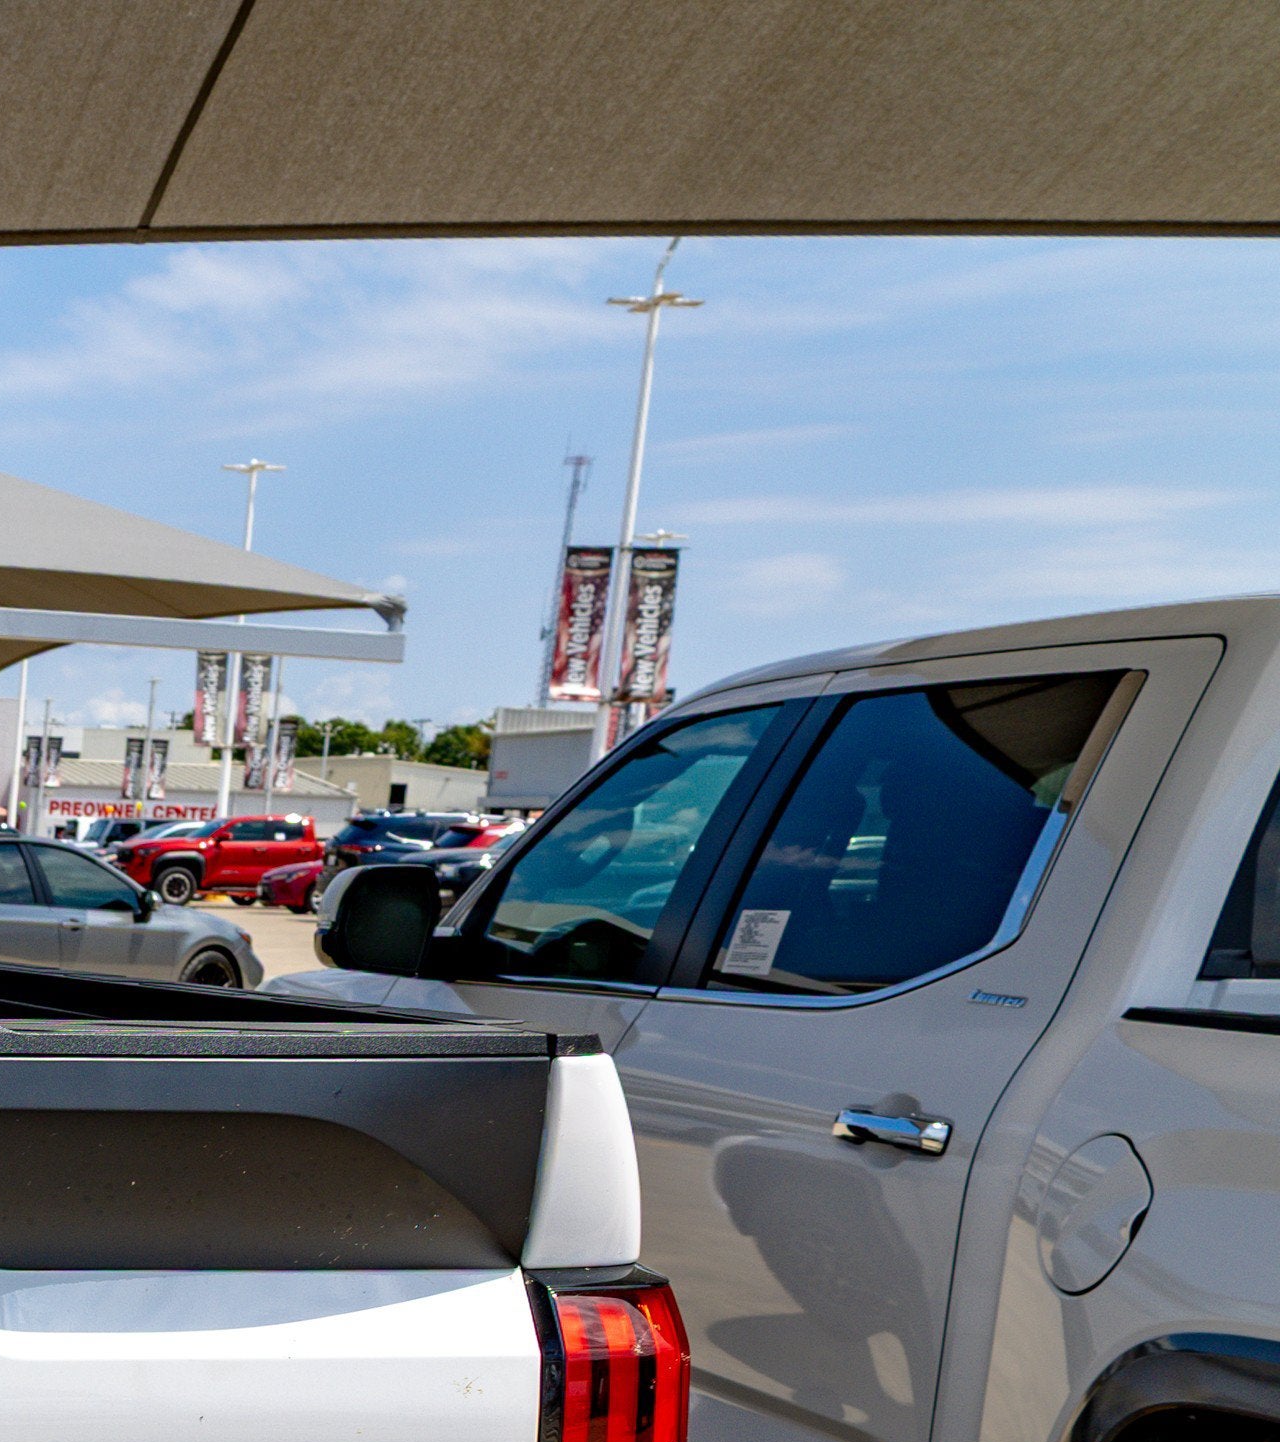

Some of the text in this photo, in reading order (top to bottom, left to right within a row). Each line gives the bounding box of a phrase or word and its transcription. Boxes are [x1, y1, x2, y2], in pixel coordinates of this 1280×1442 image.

[566, 583, 596, 656] Vehicles
[634, 584, 663, 657] Vehicles
[630, 658, 656, 698] New
